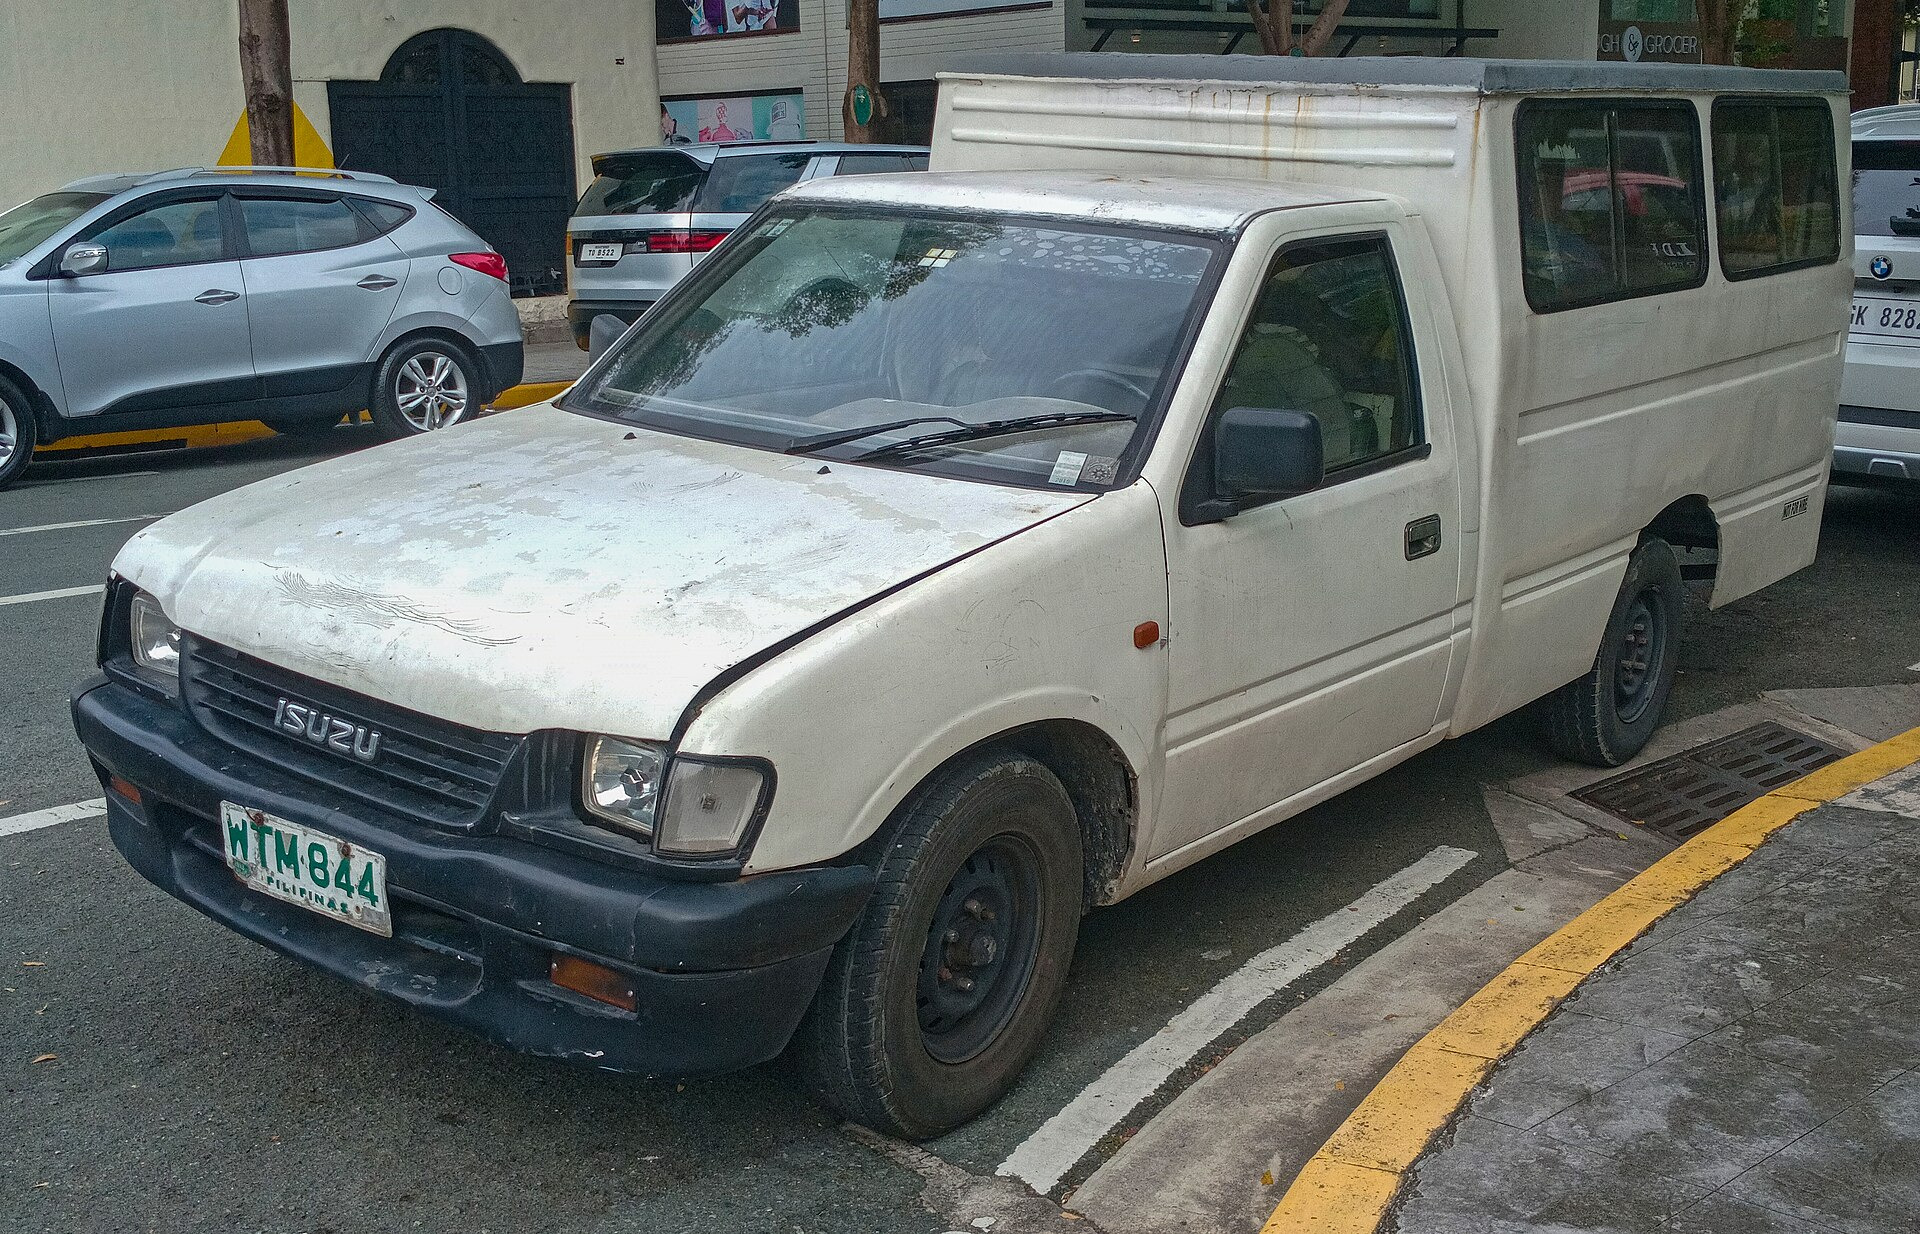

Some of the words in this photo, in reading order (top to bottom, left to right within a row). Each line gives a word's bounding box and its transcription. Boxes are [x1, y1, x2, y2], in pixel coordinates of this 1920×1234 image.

[1598, 33, 1619, 52] GH
[1645, 34, 1698, 54] GROCER
[275, 697, 381, 761] ISUZU
[266, 875, 349, 915] PILIPINAS
